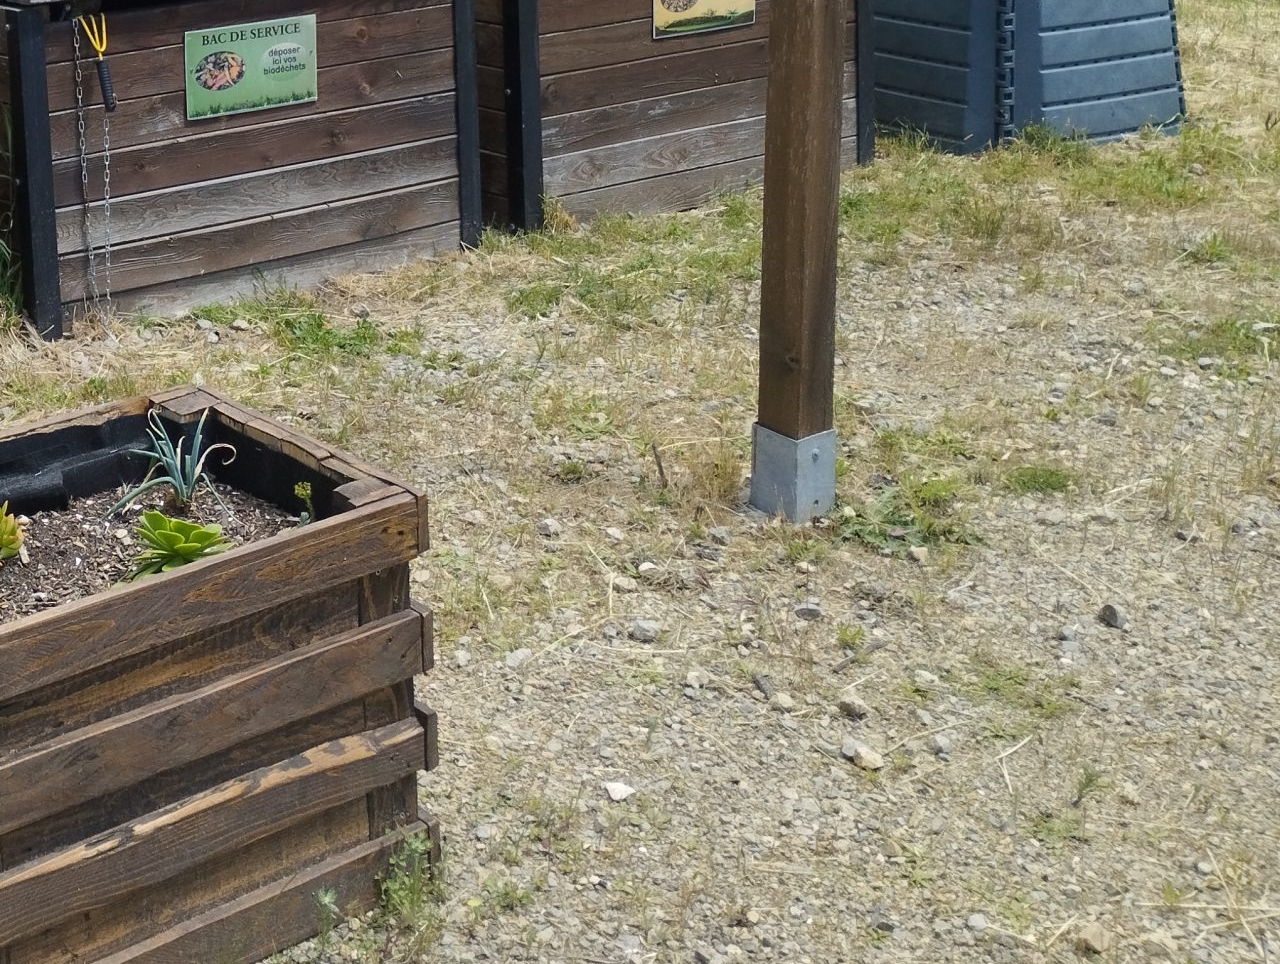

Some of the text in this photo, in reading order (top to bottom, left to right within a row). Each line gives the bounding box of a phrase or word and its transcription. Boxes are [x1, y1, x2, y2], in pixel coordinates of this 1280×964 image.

[202, 23, 301, 46] BAC DE SERVICE
[268, 46, 301, 57] déposer
[272, 56, 297, 65] ici vos
[263, 62, 306, 75] biodéchets
